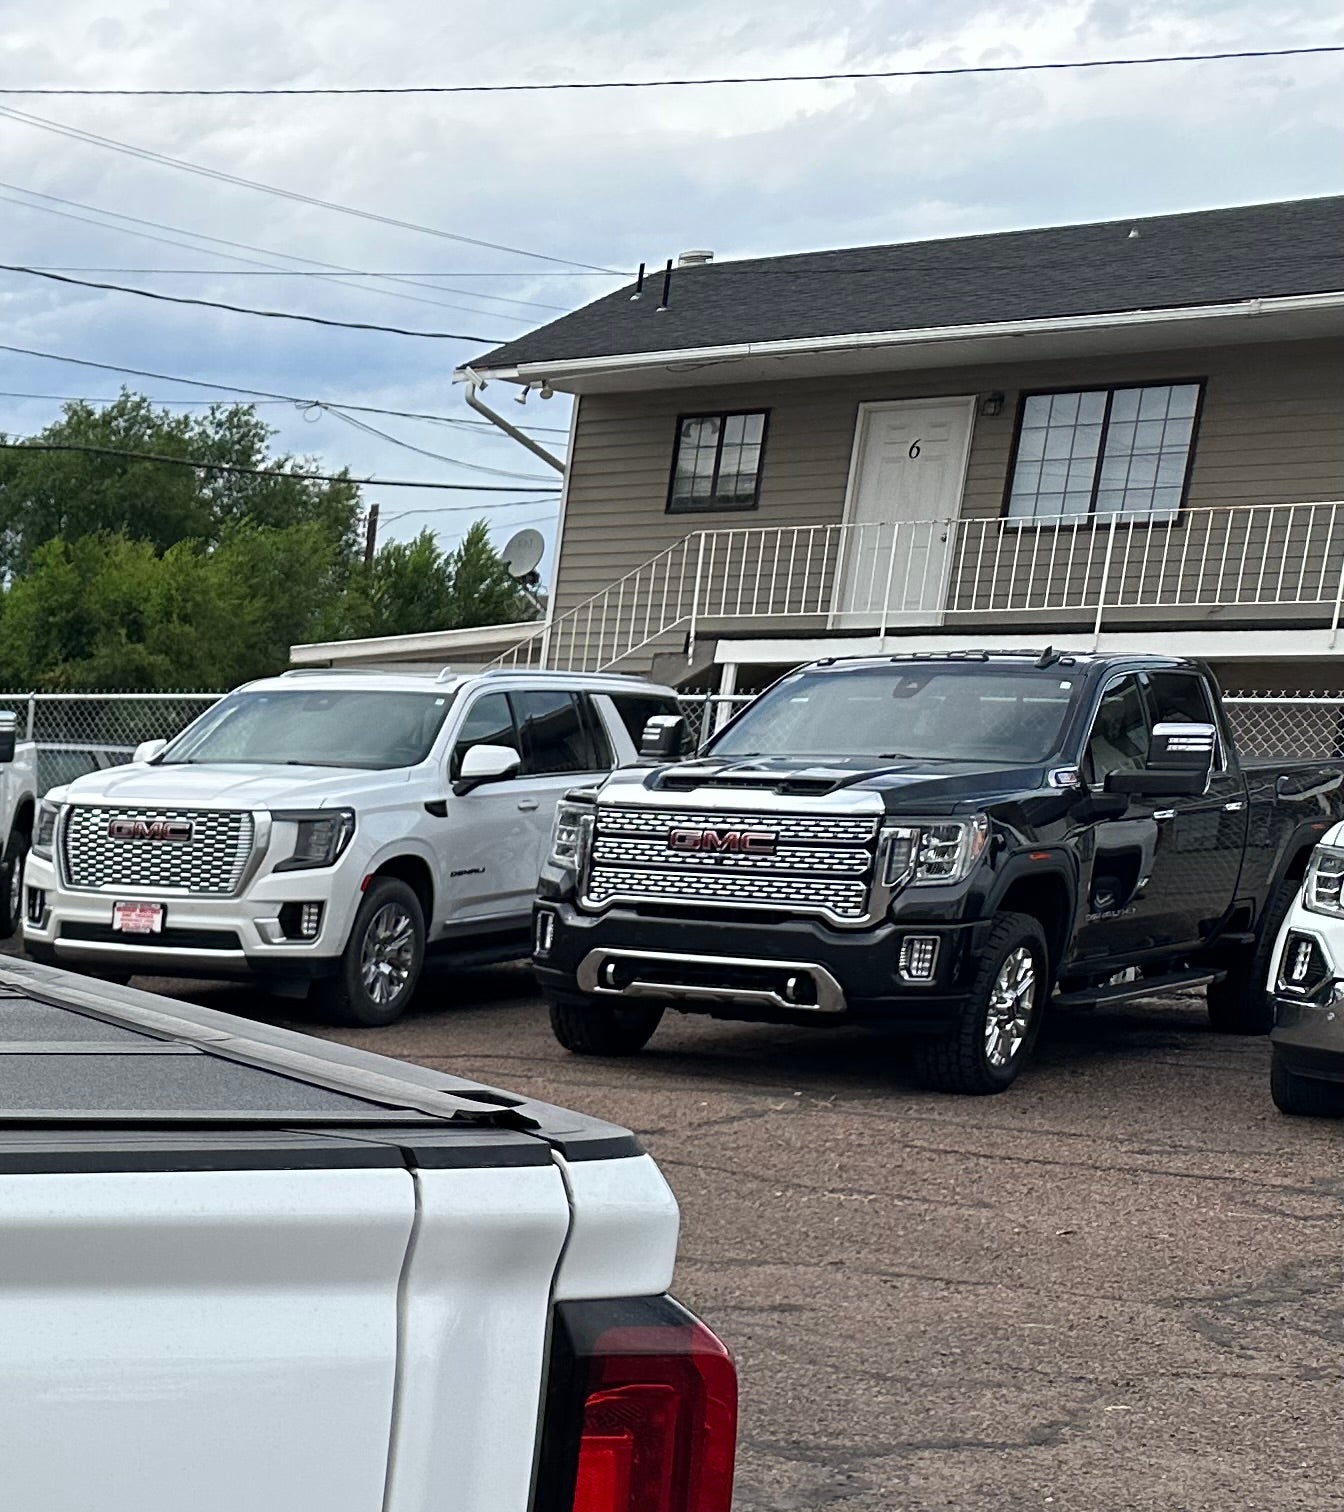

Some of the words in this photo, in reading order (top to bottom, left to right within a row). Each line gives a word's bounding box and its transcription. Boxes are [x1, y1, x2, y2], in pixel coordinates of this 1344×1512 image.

[909, 438, 922, 459] 6
[111, 821, 191, 840] GMC
[671, 829, 776, 852] GMC
